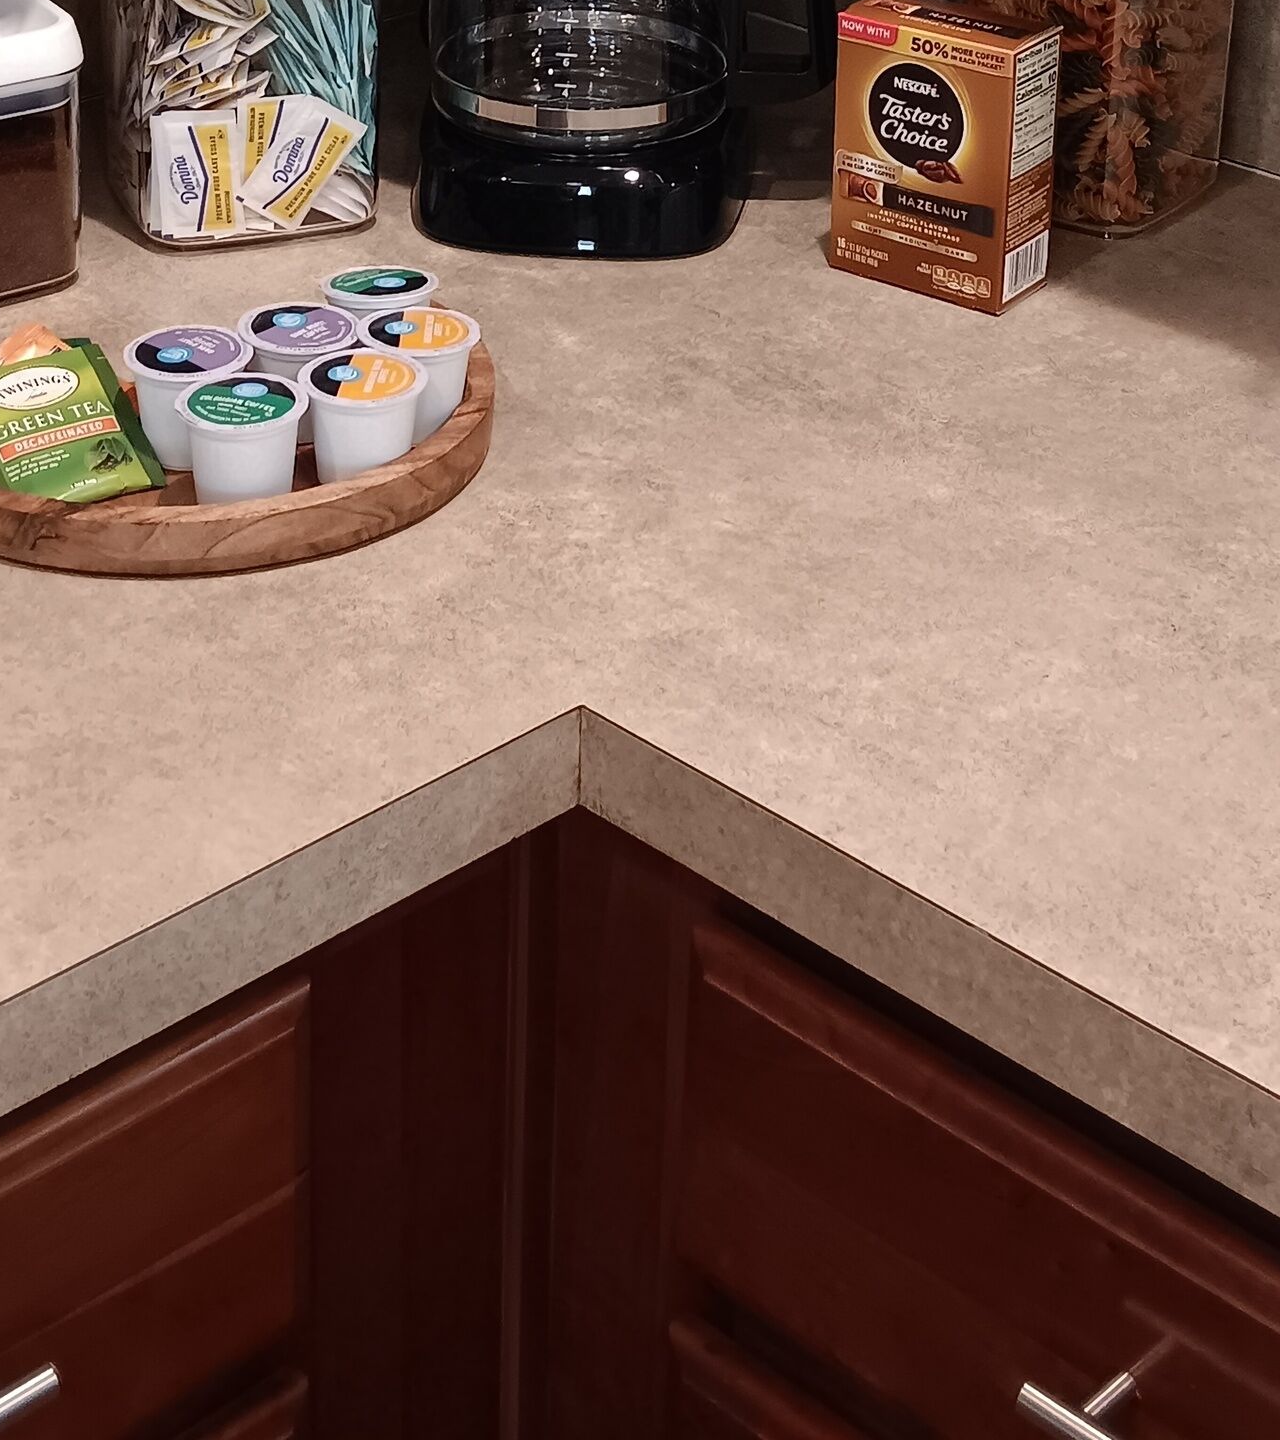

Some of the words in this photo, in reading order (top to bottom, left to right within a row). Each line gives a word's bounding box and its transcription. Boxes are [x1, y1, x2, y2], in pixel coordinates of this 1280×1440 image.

[841, 19, 865, 33] NOW
[866, 25, 891, 39] WITH
[910, 36, 949, 59] 50%
[951, 46, 973, 57] MORE
[975, 51, 1006, 64] COFFEE
[958, 56, 976, 65] EACH
[1048, 70, 1057, 84] 10
[879, 93, 952, 130] Taster's
[880, 118, 948, 153] Choice
[272, 136, 305, 183] Domino
[174, 154, 199, 205] Domino
[898, 193, 968, 221] HAZELNUT
[867, 212, 895, 224] INSTANT
[896, 221, 922, 232] COFFEE
[879, 209, 918, 225] ARTIFICIAL
[919, 220, 949, 233] FLAVOR
[67, 400, 111, 419] TEA
[14, 420, 104, 453] DECAFFEINATED
